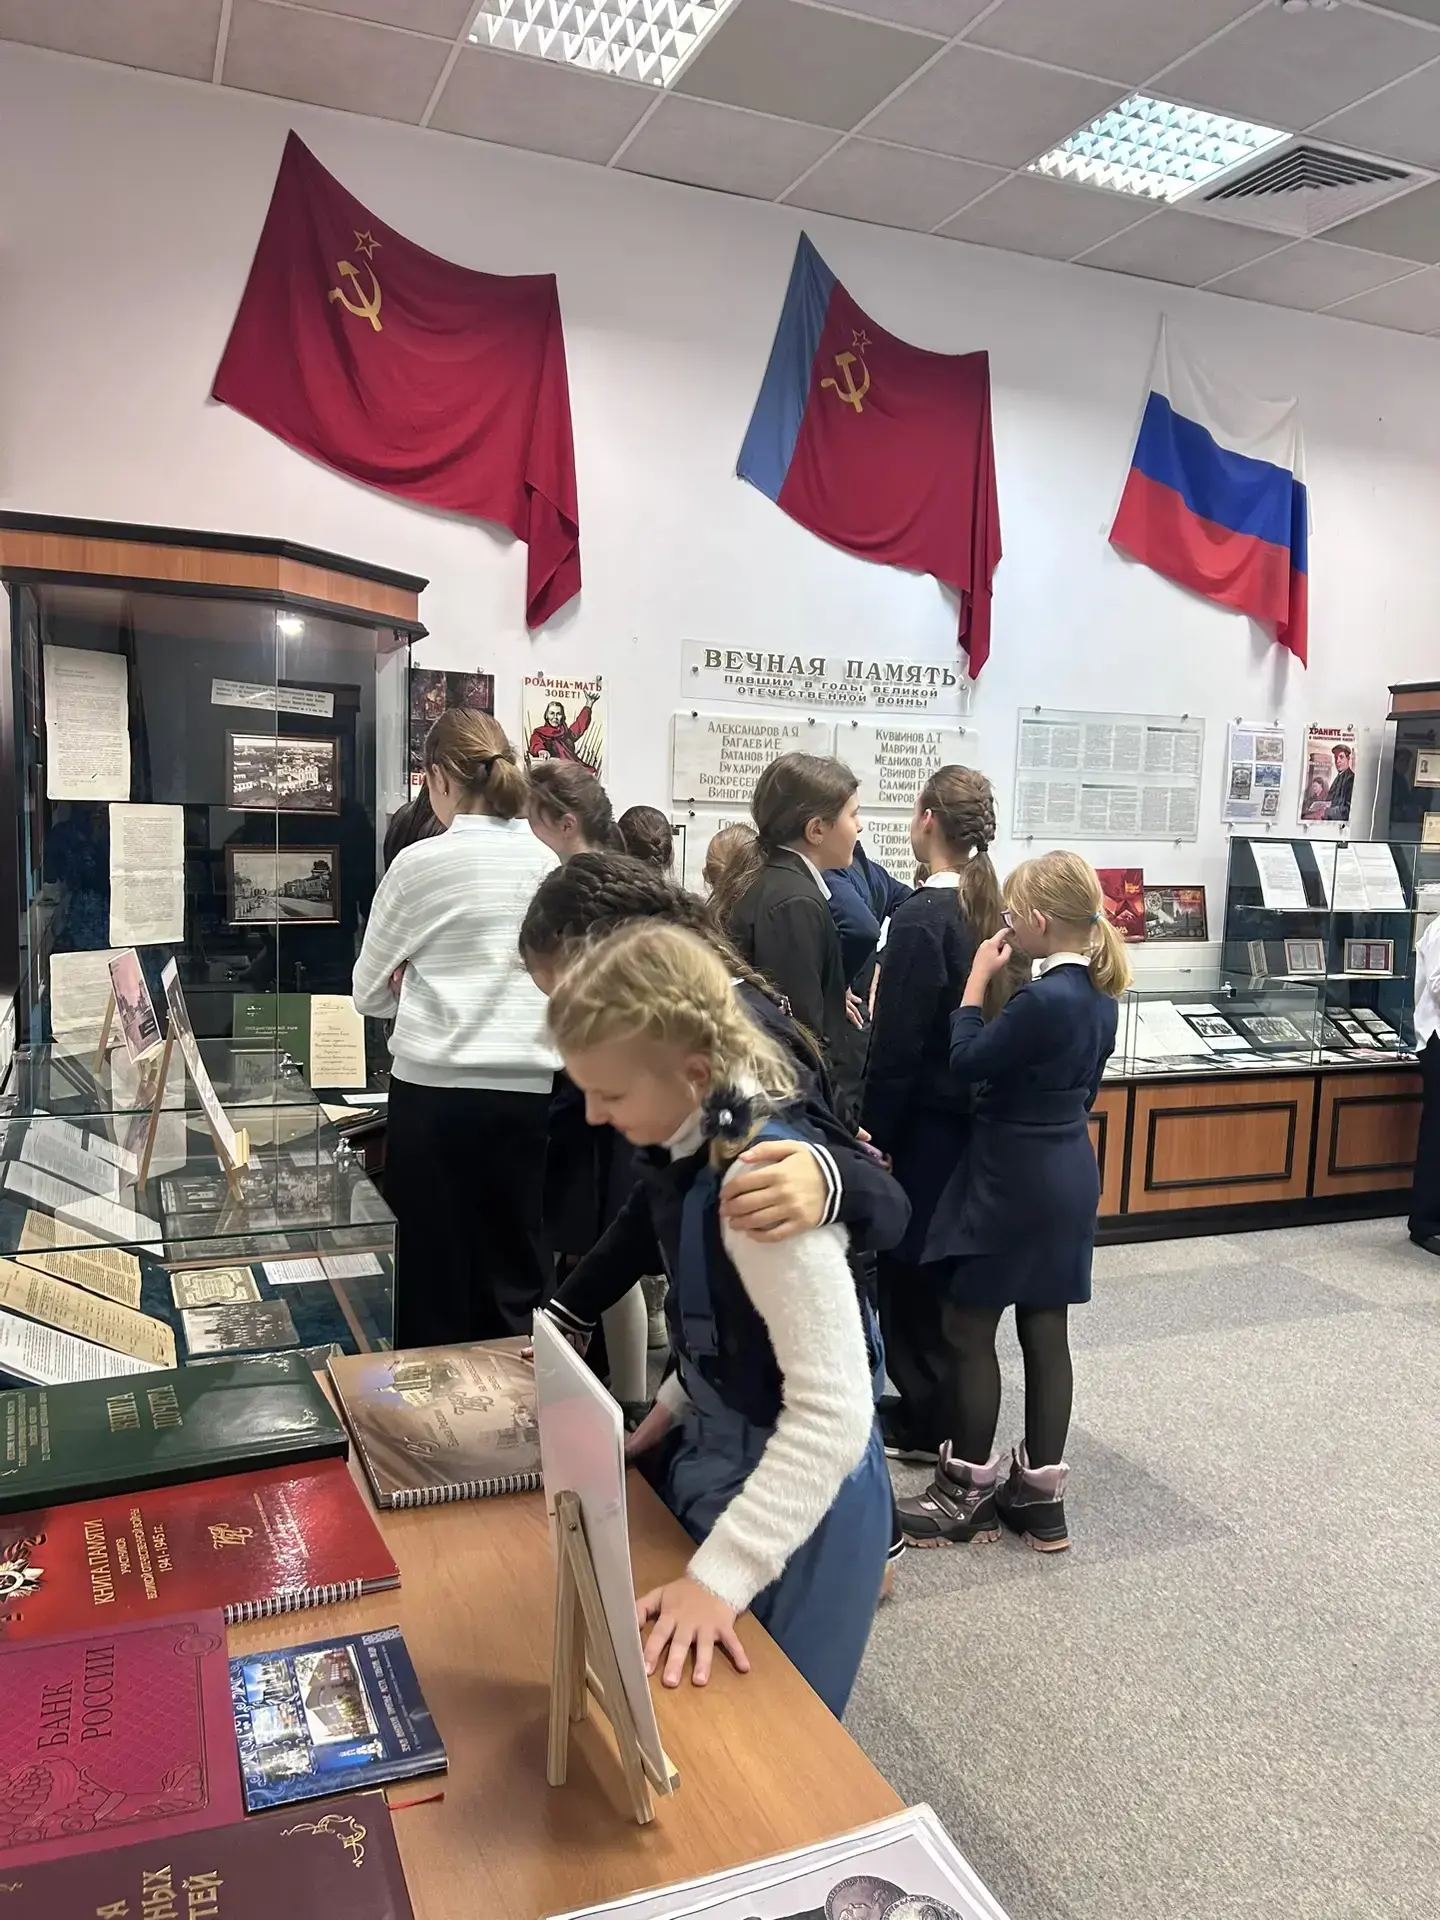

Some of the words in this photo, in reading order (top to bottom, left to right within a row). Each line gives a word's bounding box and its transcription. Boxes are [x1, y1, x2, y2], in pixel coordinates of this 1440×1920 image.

[704, 648, 827, 677] ВЕЧНАЯ
[845, 659, 957, 686] ПАМЯТЬ
[524, 676, 602, 692] РОДИНА-МАТЬ
[724, 674, 794, 687] ПАВШИМ
[804, 681, 813, 689] В
[821, 681, 863, 692] ГОДЫ
[873, 685, 938, 698] ВЕЛИКОЙ
[544, 689, 580, 699] ЗОВЕТ!
[737, 686, 867, 702] ОТЕЧЕСТВЕННОЙ
[877, 694, 928, 707] ВОЙНЫ
[707, 720, 779, 737] АЛЕКСАНДРОВ
[875, 729, 924, 742] КУВШИНОВ
[1308, 727, 1341, 737] ХРАНИТЕ
[722, 735, 762, 749] БАГАЕВ
[881, 742, 917, 755] МАВРИН
[721, 748, 763, 762] БАТАНОВ
[874, 754, 922, 767] МЕДНИКОВ
[719, 761, 764, 774] БУХАРИН
[880, 767, 916, 779] СВИНОВ
[699, 773, 759, 787] ВОСКРЕСЕН
[879, 778, 915, 791] САЛМИН
[708, 786, 754, 799] ВИНОГРА
[878, 790, 915, 803] СМУРОВ
[868, 821, 911, 833] СТРЕЖЕН
[873, 833, 910, 844] СТОЮНИ
[879, 845, 910, 857] ТЮРИН
[106, 1392, 140, 1432] КНИГА
[146, 1384, 184, 1429] ПОЧЕТА
[129, 1507, 143, 1530] ВОЙНЫ
[83, 1518, 109, 1566] ПАМЯТИ
[115, 1537, 132, 1575] УЧАСТНИКОВ
[131, 1529, 152, 1573] ОТЕЧЕСТВЕННОЙ
[152, 1533, 173, 1572] 1941-1945
[90, 1564, 116, 1605] КНИГА
[141, 1572, 158, 1600] ВЕЛИКОЙ
[80, 1644, 115, 1743] РОССИИ
[37, 1680, 74, 1750] БАНК
[141, 1864, 179, 1920] НЫХ
[181, 1870, 225, 1920] ТЕЙ
